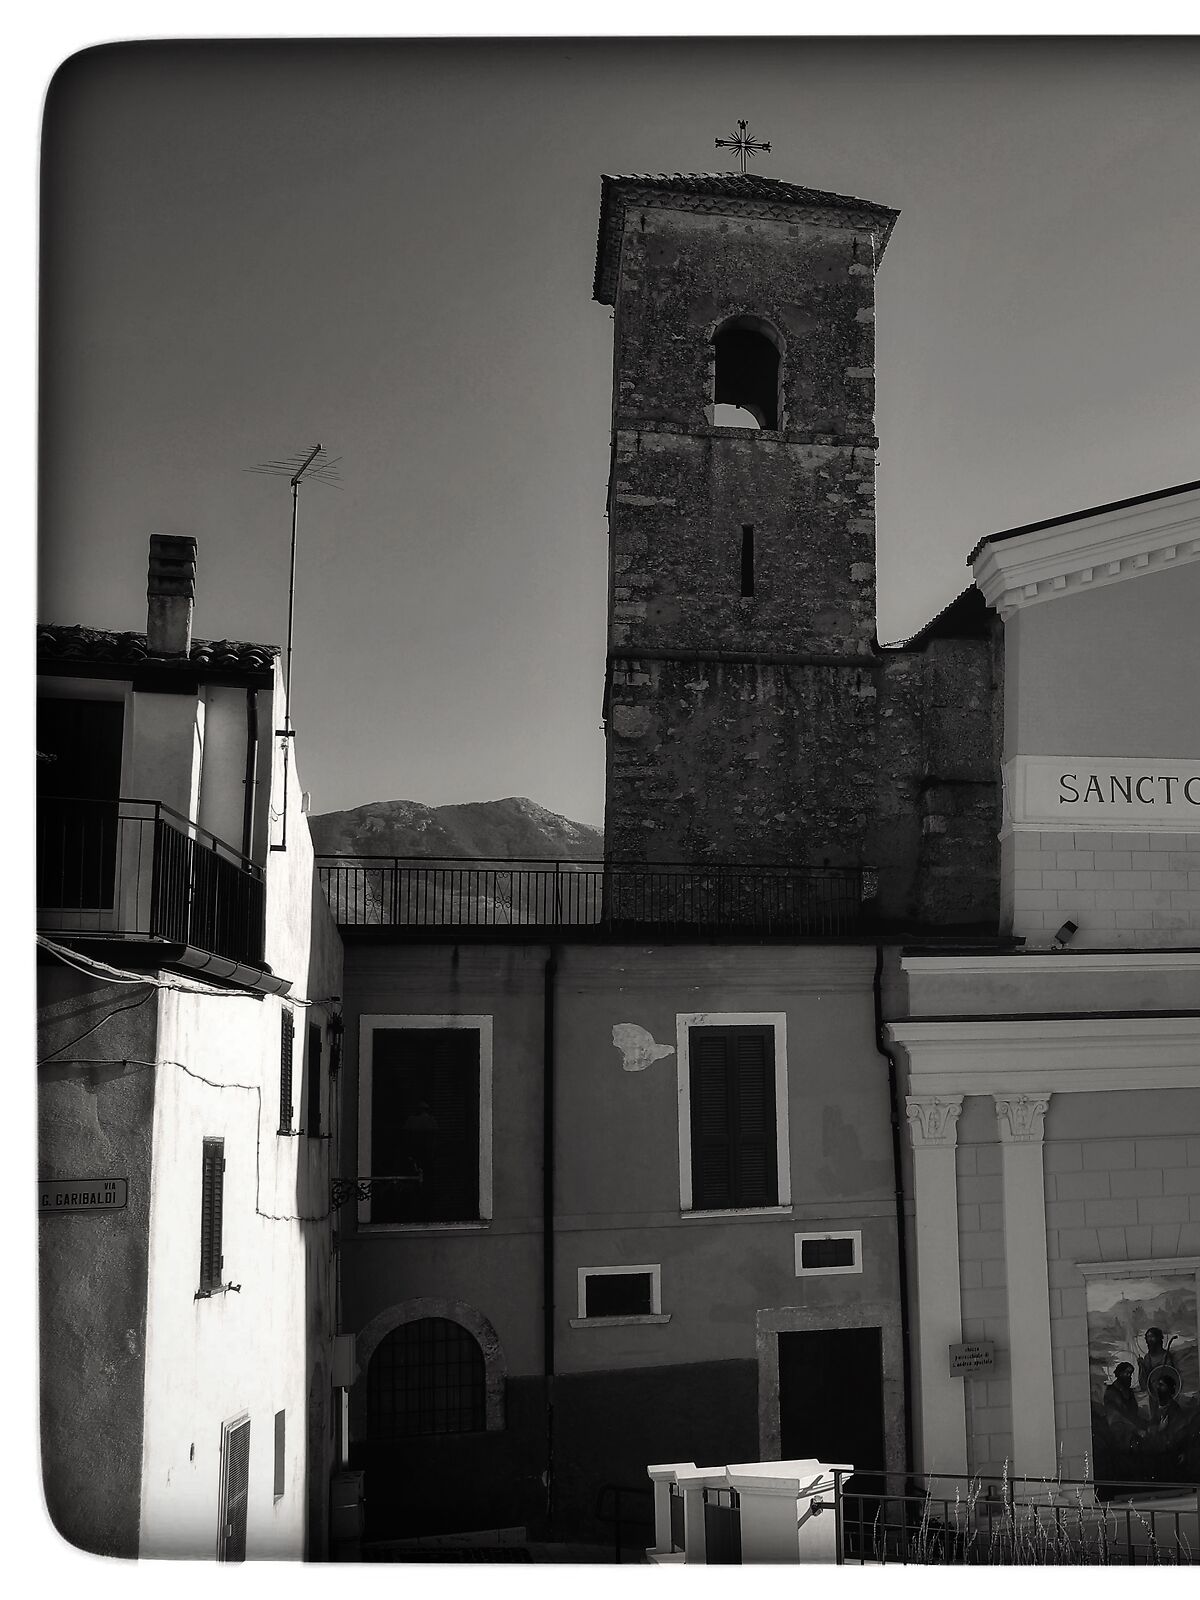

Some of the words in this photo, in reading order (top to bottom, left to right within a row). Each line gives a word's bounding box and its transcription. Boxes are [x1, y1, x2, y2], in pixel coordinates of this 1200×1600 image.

[104, 1182, 116, 1190] VIA
[42, 1194, 52, 1206] G.
[55, 1192, 116, 1206] GARIBALDI
